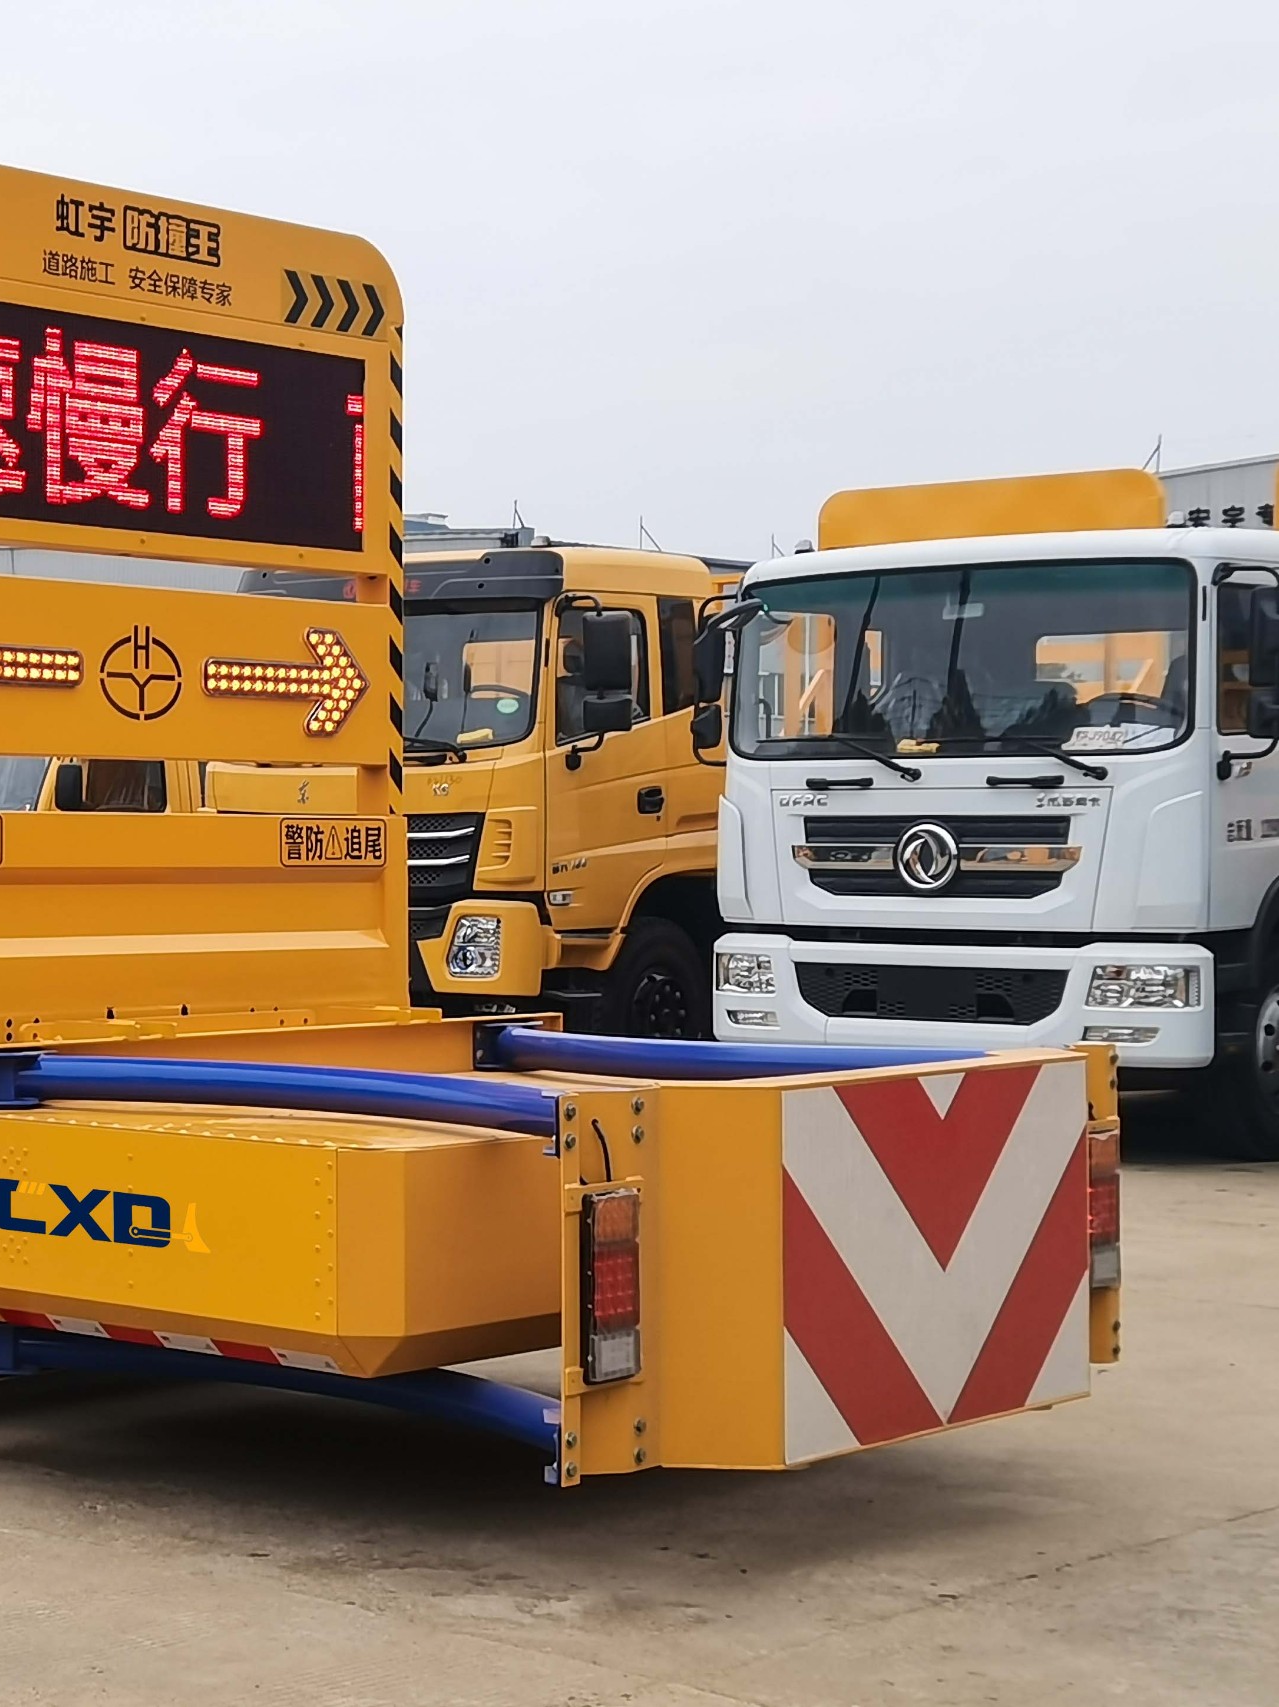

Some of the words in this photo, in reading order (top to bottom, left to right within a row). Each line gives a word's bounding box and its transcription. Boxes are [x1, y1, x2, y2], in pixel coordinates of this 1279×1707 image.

[55, 193, 116, 242] 虹宇
[123, 204, 222, 268] 防撞王
[42, 249, 116, 286] 道路施工
[128, 266, 232, 307] 安全保障专家
